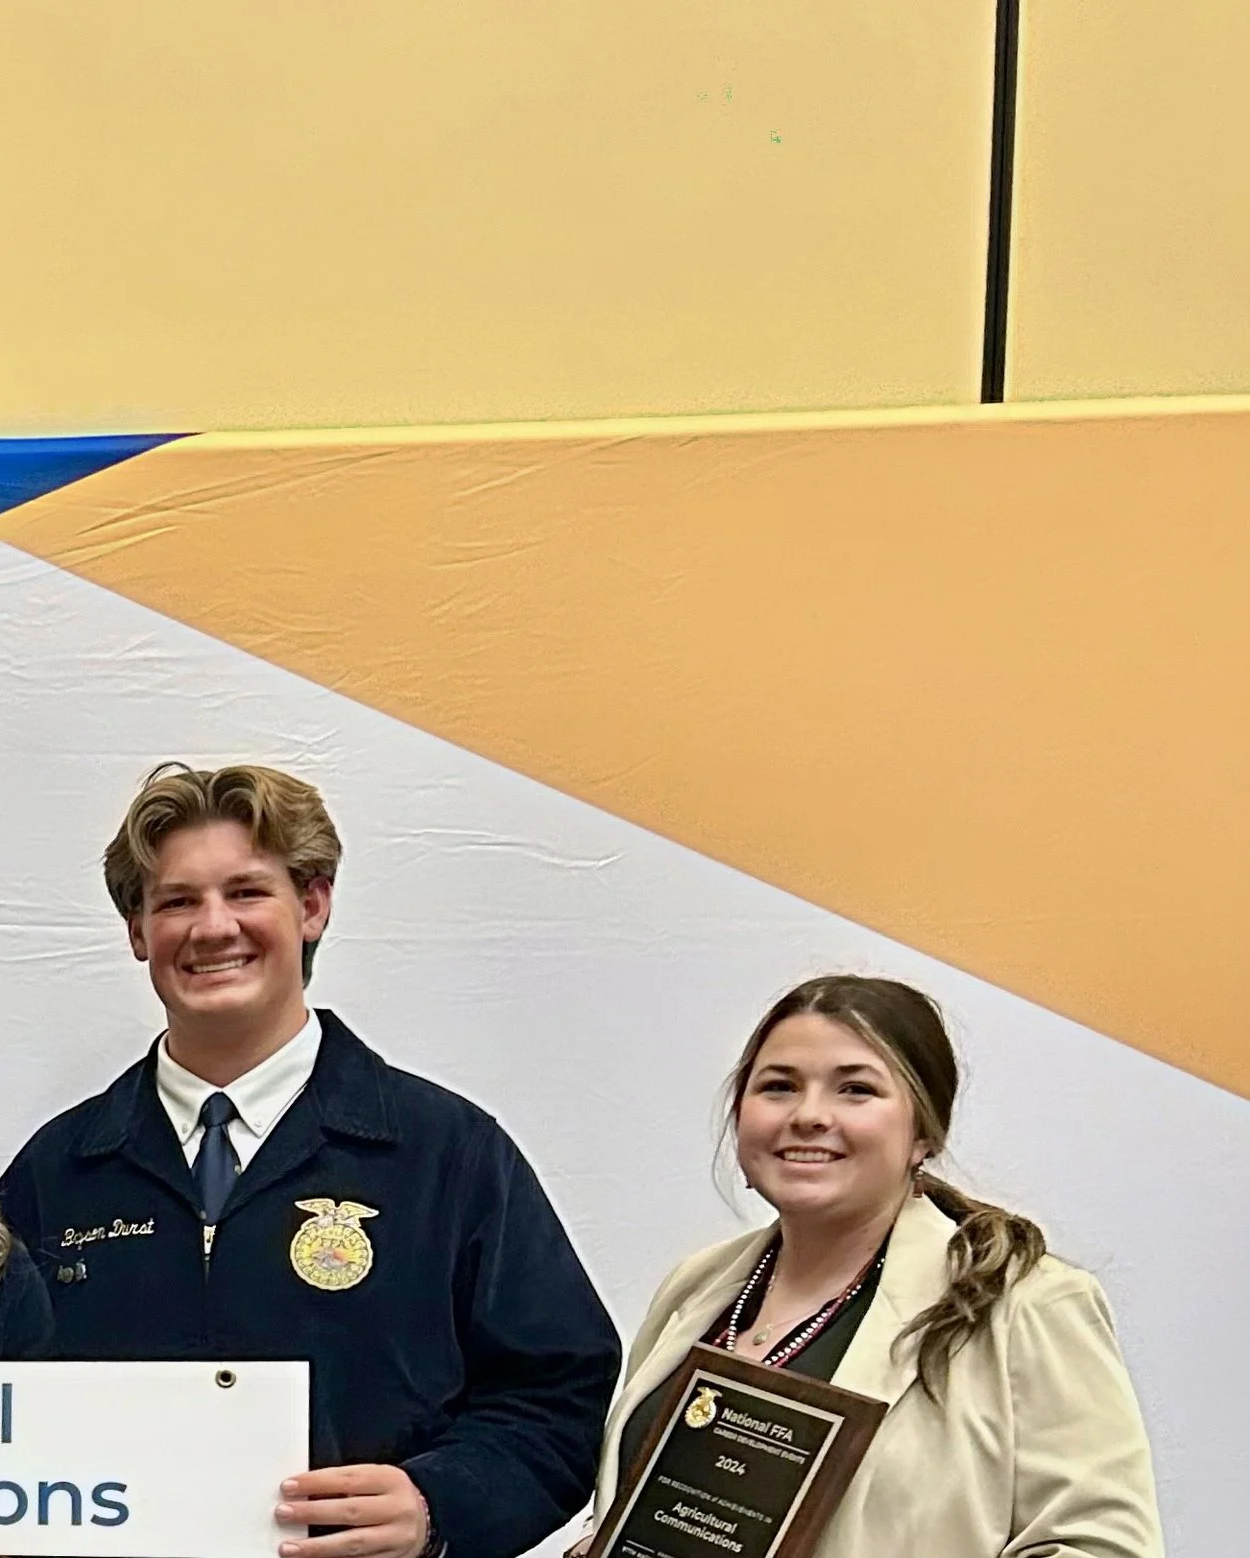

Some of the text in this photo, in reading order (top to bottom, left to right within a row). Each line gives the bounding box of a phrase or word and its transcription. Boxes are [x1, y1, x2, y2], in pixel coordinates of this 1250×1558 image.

[108, 1218, 155, 1238] Durst
[721, 1407, 794, 1442] National FFA
[715, 1455, 747, 1476] 2024
[654, 1510, 743, 1553] Communications
[672, 1502, 738, 1534] Agricultural
